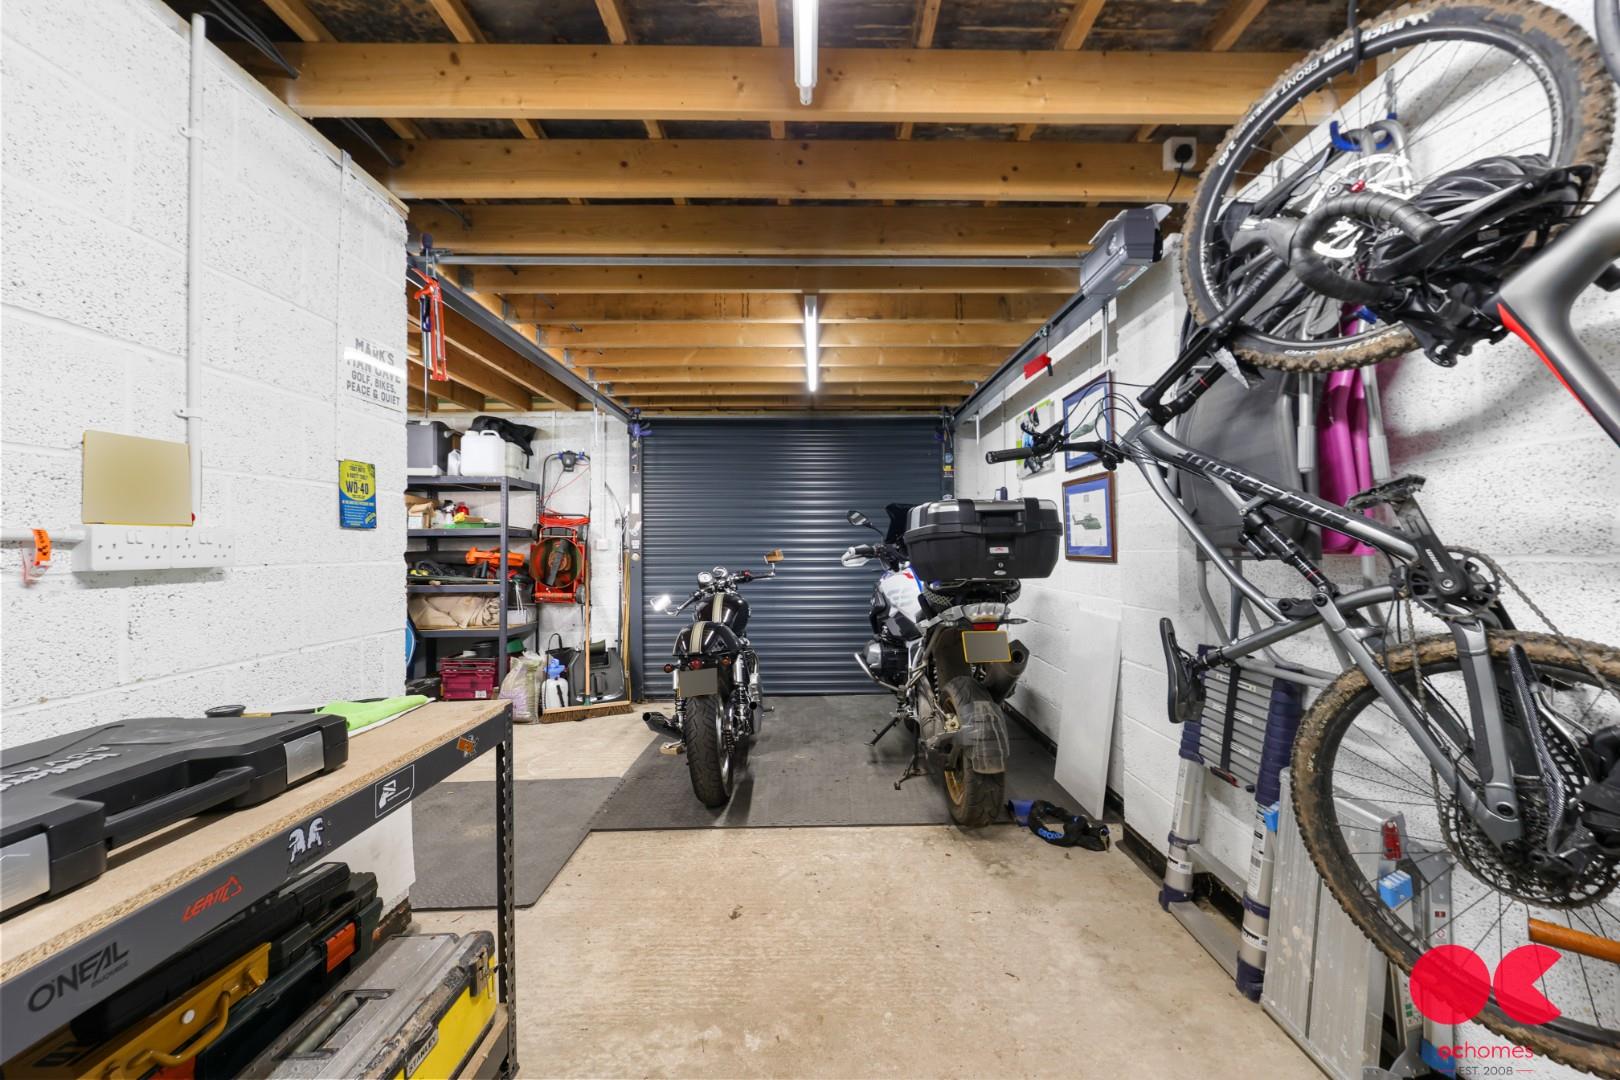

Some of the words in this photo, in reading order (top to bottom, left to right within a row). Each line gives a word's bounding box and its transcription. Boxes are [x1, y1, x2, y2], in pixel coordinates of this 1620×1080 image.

[1280, 59, 1320, 95] FRONT
[346, 380, 371, 397] PEACE
[381, 391, 401, 407] QUIET
[346, 480, 369, 495] WD-40
